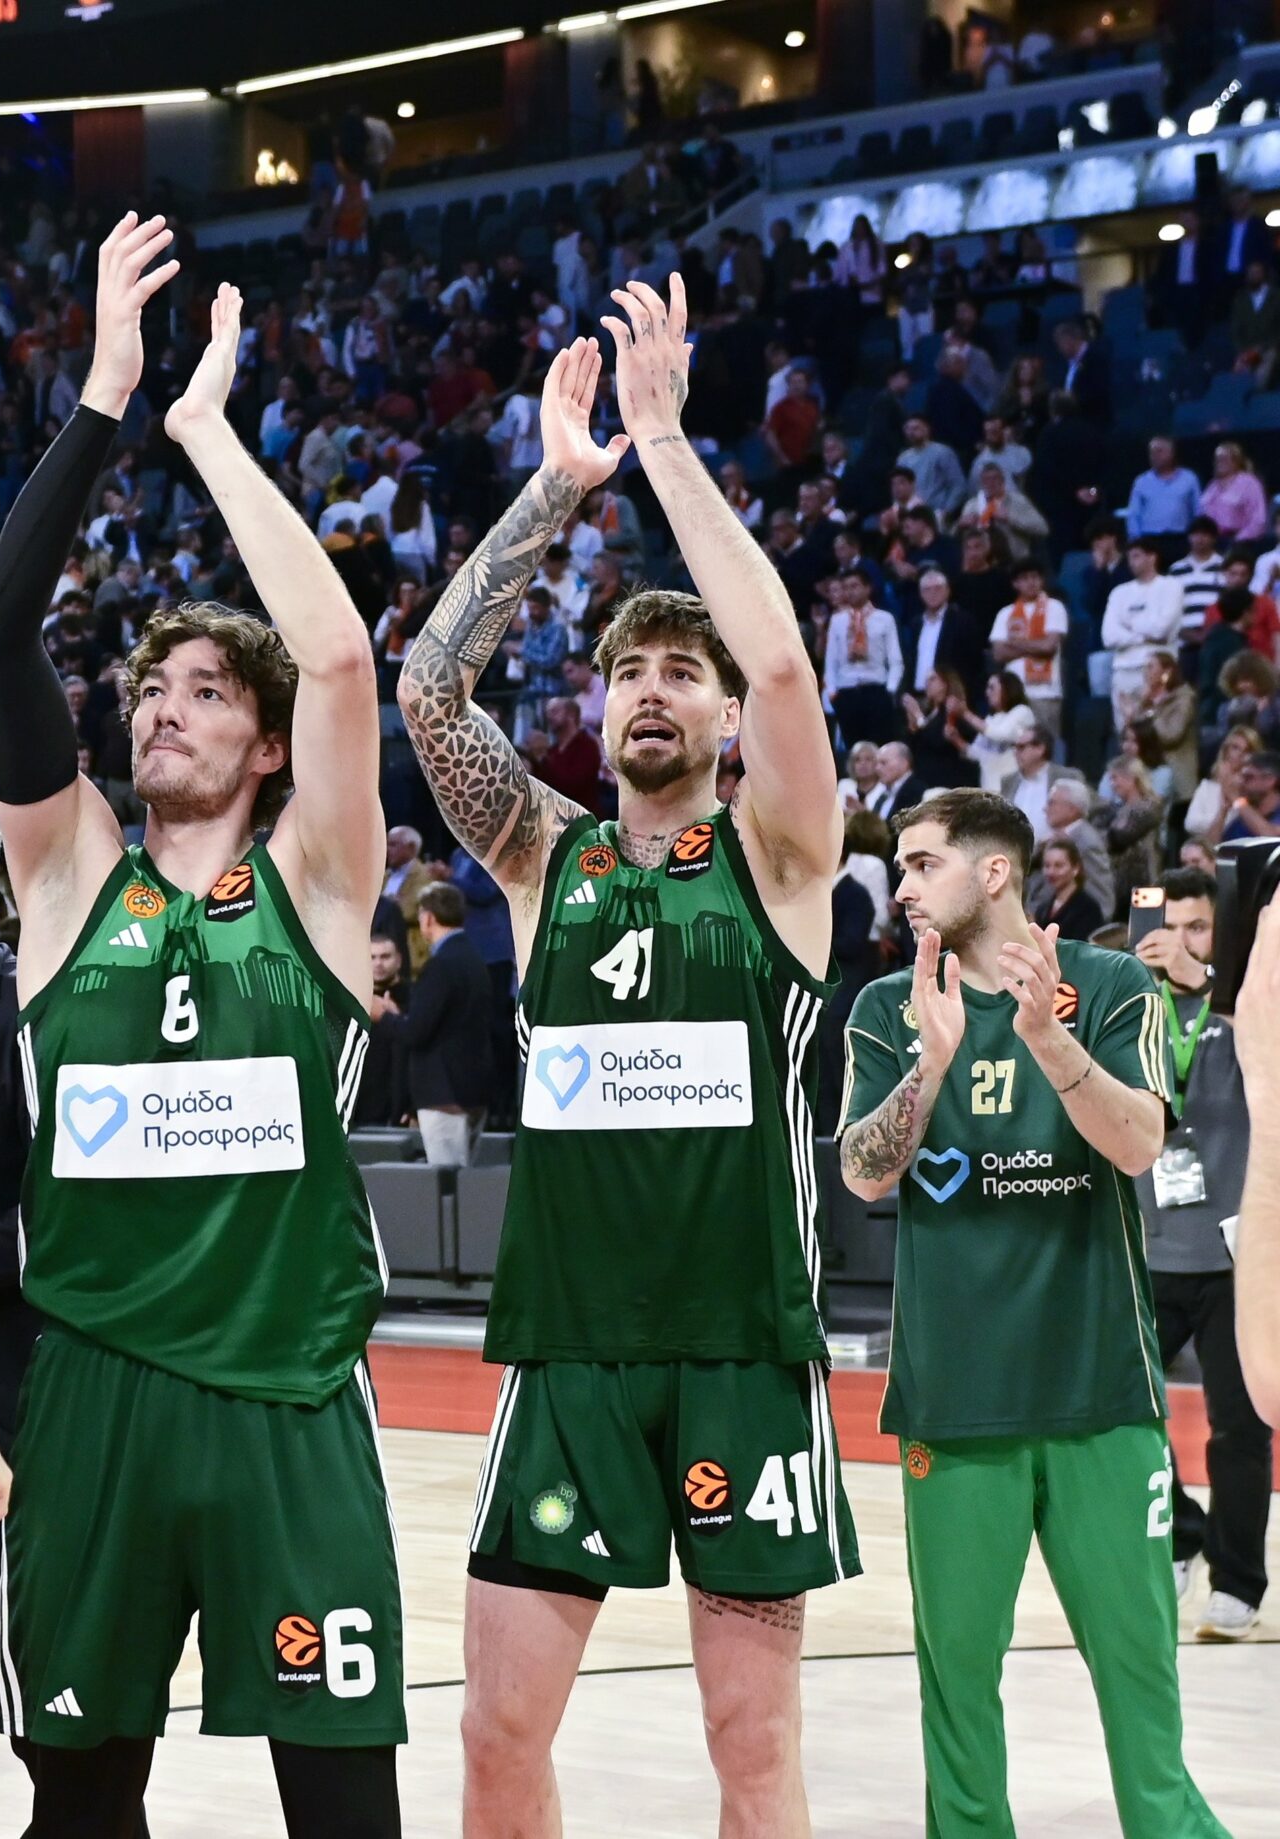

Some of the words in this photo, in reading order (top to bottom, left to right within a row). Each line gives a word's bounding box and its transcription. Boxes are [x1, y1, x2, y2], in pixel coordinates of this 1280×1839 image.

[669, 861, 709, 873] EuroLeague
[208, 900, 254, 916] EuroLeague
[590, 927, 654, 1001] 41
[161, 974, 200, 1044] 6
[600, 1049, 682, 1077] Ομάδα
[602, 1079, 743, 1108] Προσφοράς
[971, 1058, 1016, 1115] 27
[142, 1090, 233, 1121] Ομάδα
[144, 1119, 295, 1154] Προσφοράς
[981, 1149, 1053, 1175] Ομάδα
[560, 1485, 573, 1499] bp
[745, 1450, 818, 1537] 41
[690, 1514, 732, 1526] EuroLeague
[323, 1607, 377, 1698] 6
[278, 1672, 321, 1684] EuroLeague
